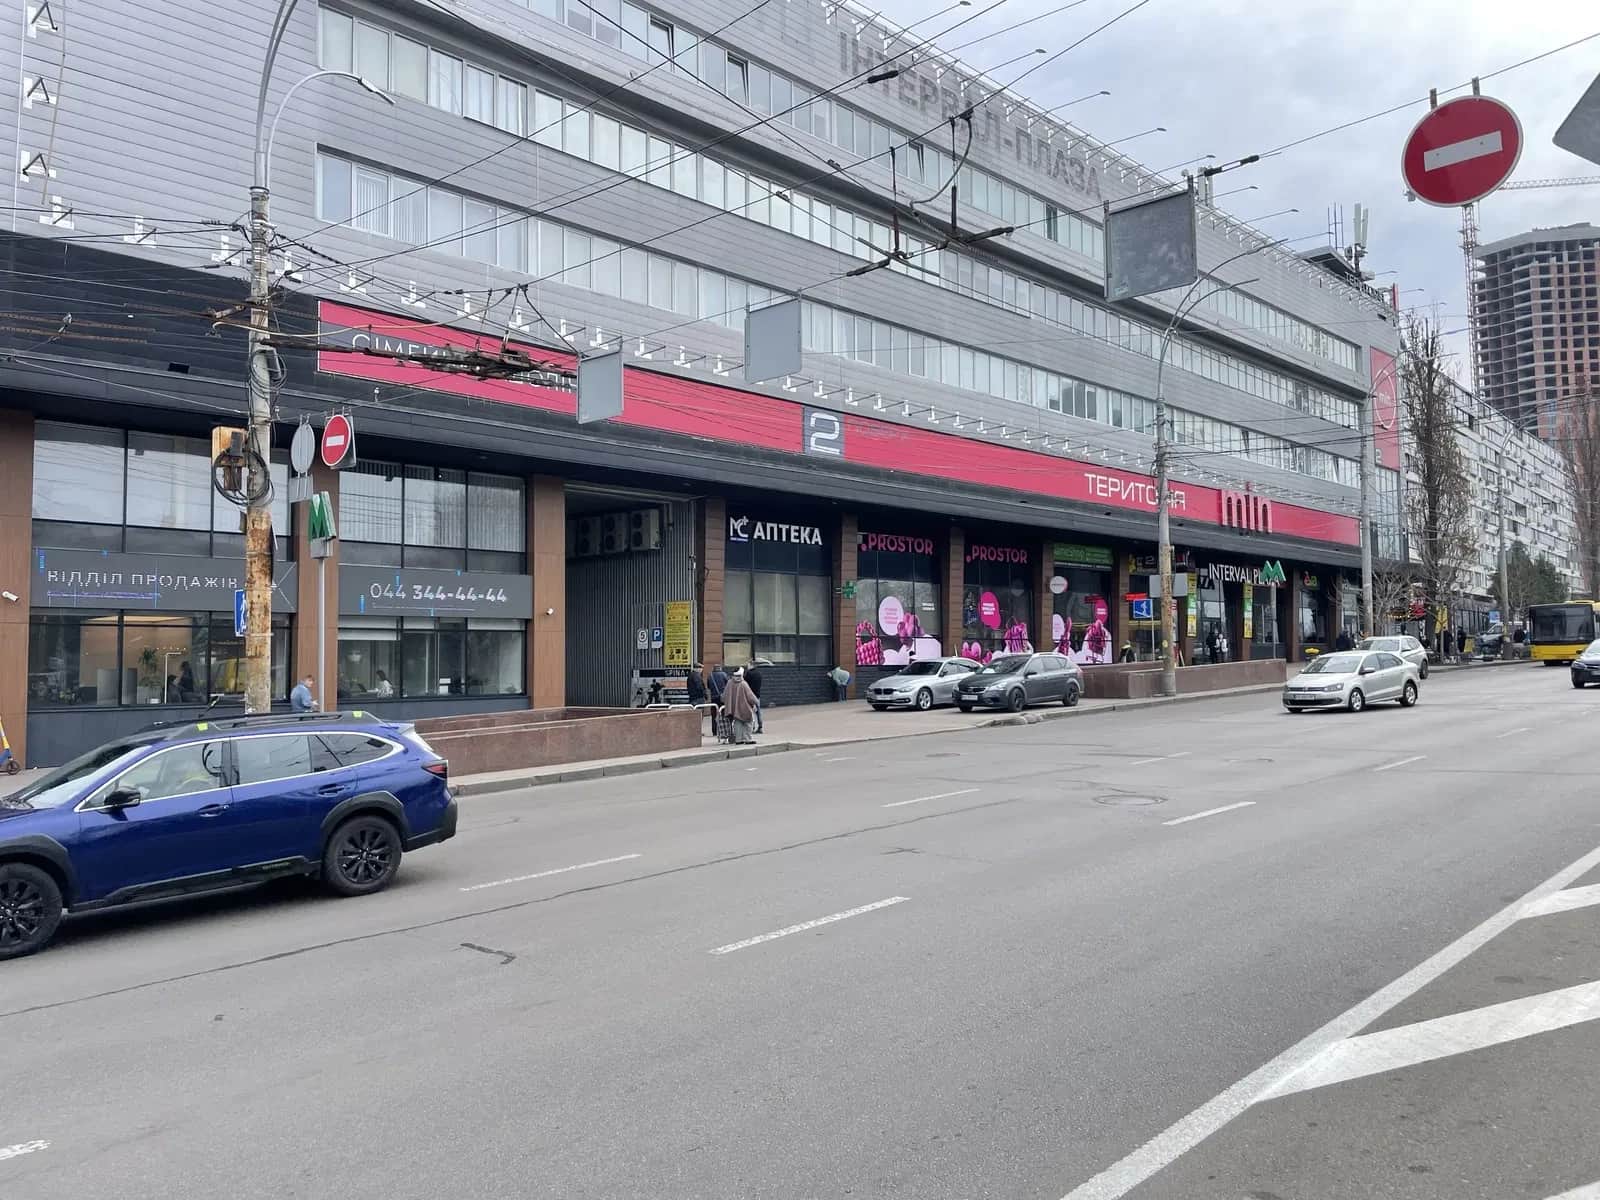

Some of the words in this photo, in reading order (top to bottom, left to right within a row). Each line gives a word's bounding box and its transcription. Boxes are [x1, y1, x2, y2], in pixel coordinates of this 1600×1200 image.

[810, 412, 840, 455] 2
[1084, 473, 1186, 511] ТЕРИТОІЯ
[753, 521, 823, 546] АПТЕКА
[47, 570, 122, 587] ВІДДІЛ
[131, 573, 238, 591] ПРОДАЖІВ
[1208, 563, 1250, 584] INTERVAL
[369, 583, 406, 599] 044
[412, 584, 508, 603] 344-44-44
